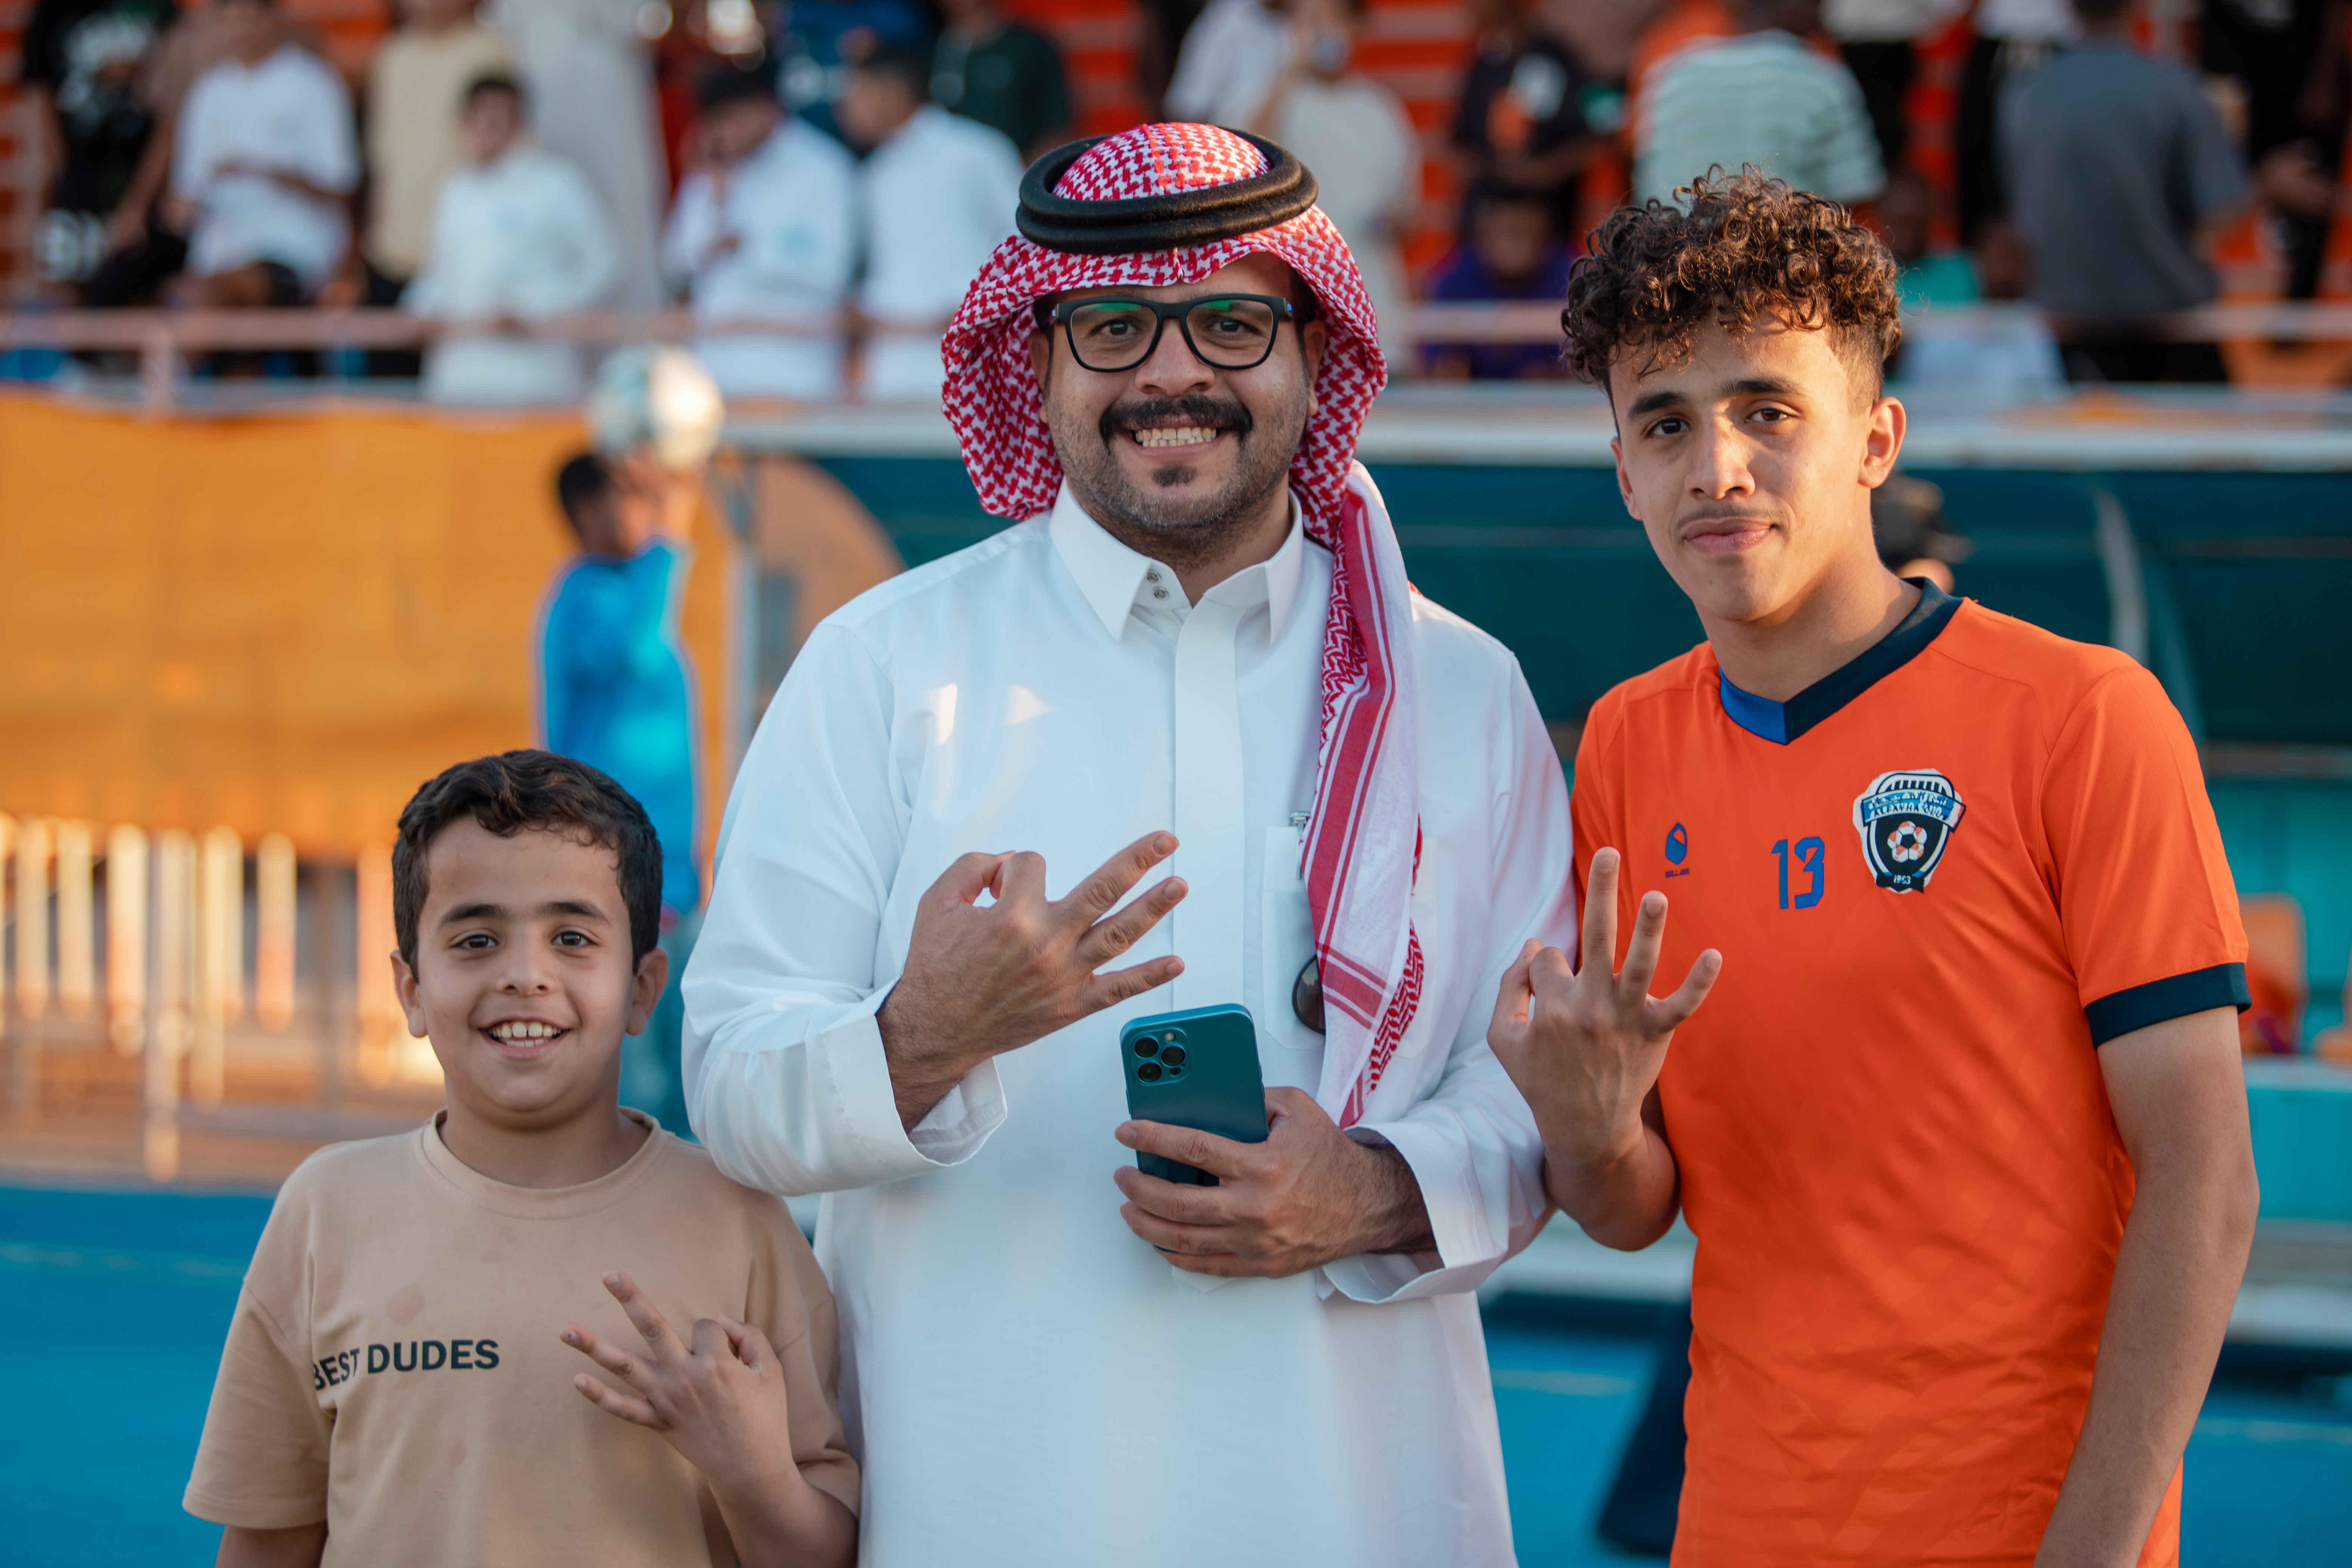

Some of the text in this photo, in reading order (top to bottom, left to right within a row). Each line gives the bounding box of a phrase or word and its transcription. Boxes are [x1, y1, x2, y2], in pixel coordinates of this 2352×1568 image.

[1771, 836, 1824, 910] 13
[313, 1339, 499, 1390] BEST DUDES
